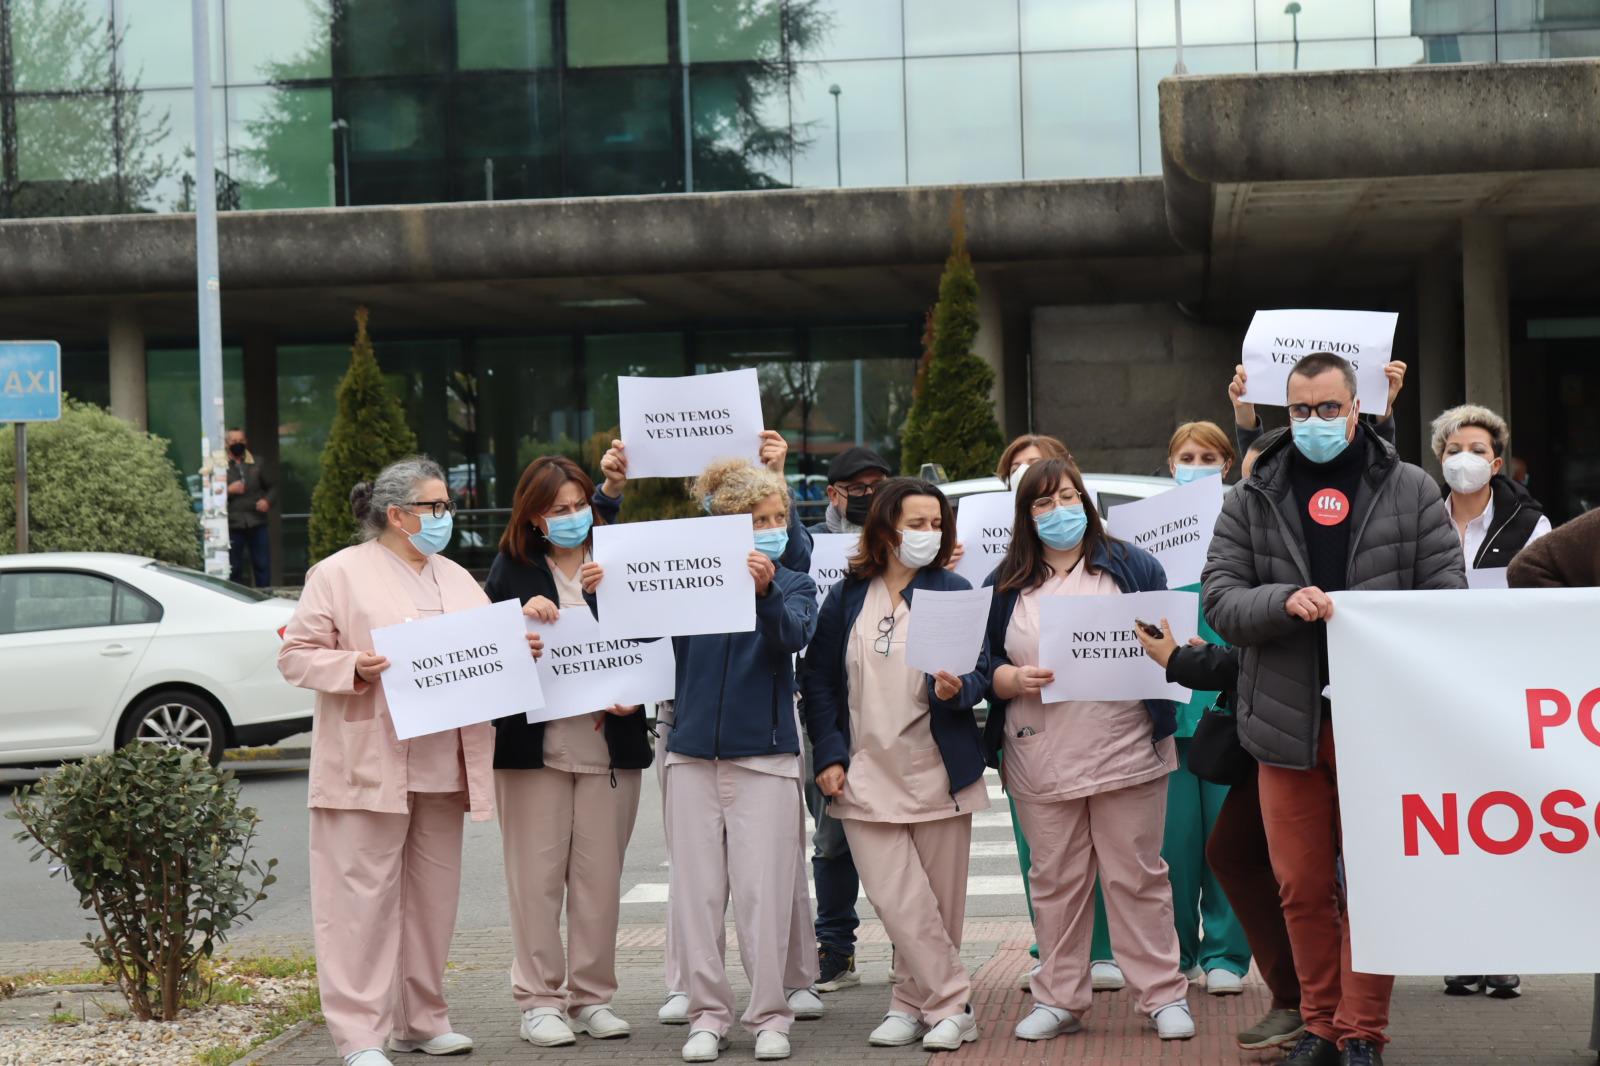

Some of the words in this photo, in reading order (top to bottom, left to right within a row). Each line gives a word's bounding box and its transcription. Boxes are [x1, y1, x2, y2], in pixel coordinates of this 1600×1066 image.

[1273, 336, 1305, 350] NON
[1308, 339, 1360, 354] TEMOS
[0, 370, 55, 394] AXI
[644, 412, 675, 424] NON
[678, 408, 730, 422] TEMOS
[646, 424, 734, 440] VESTIARIOS
[982, 527, 1013, 538] NON
[1134, 528, 1158, 545] NON
[1160, 514, 1199, 536] TEMOS
[1147, 530, 1201, 554] STIARIOS
[626, 560, 661, 575] NON
[664, 556, 722, 572] TEMOS
[627, 574, 724, 593] VESTIARIOS
[1072, 631, 1106, 643] NON
[411, 655, 444, 673] NON
[446, 642, 498, 664] TEMOS
[550, 644, 582, 659] NON
[585, 639, 640, 655] TEMOS
[1071, 646, 1144, 659] VESTIARI
[552, 653, 643, 676] VESTIARIOS
[414, 660, 504, 689] VESTIARIOS
[1401, 788, 1600, 857] NOS
